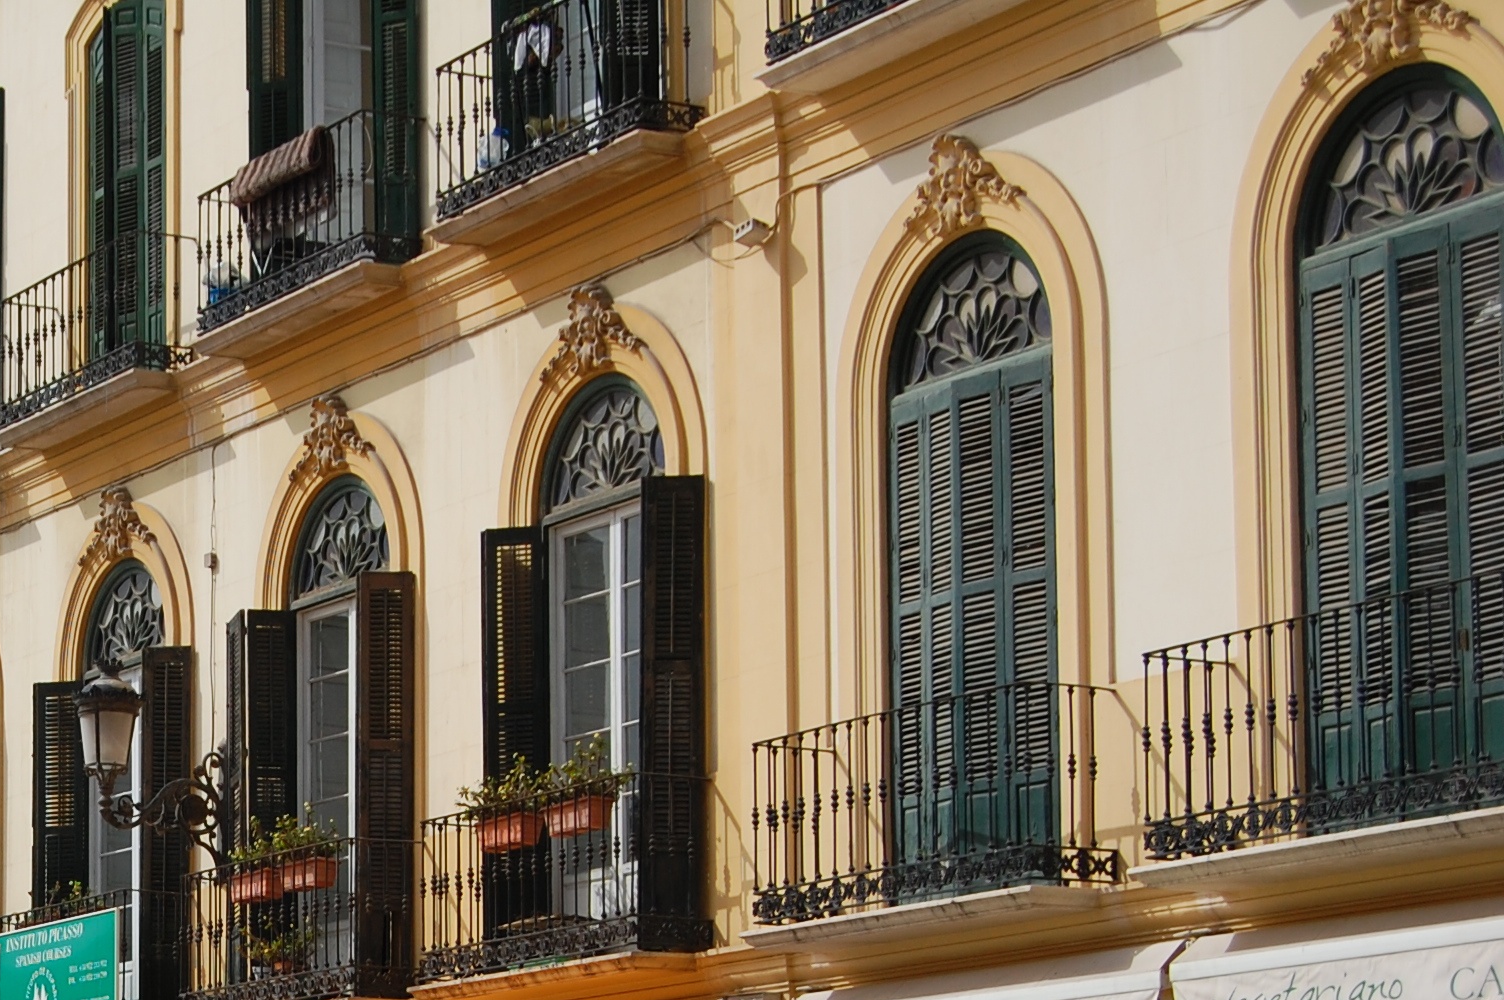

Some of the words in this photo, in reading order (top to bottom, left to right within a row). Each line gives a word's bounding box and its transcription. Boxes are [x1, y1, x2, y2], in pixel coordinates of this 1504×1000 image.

[6, 931, 47, 953] INSTITUTO
[48, 922, 84, 944] PICASSO
[15, 952, 43, 968] SPANISH
